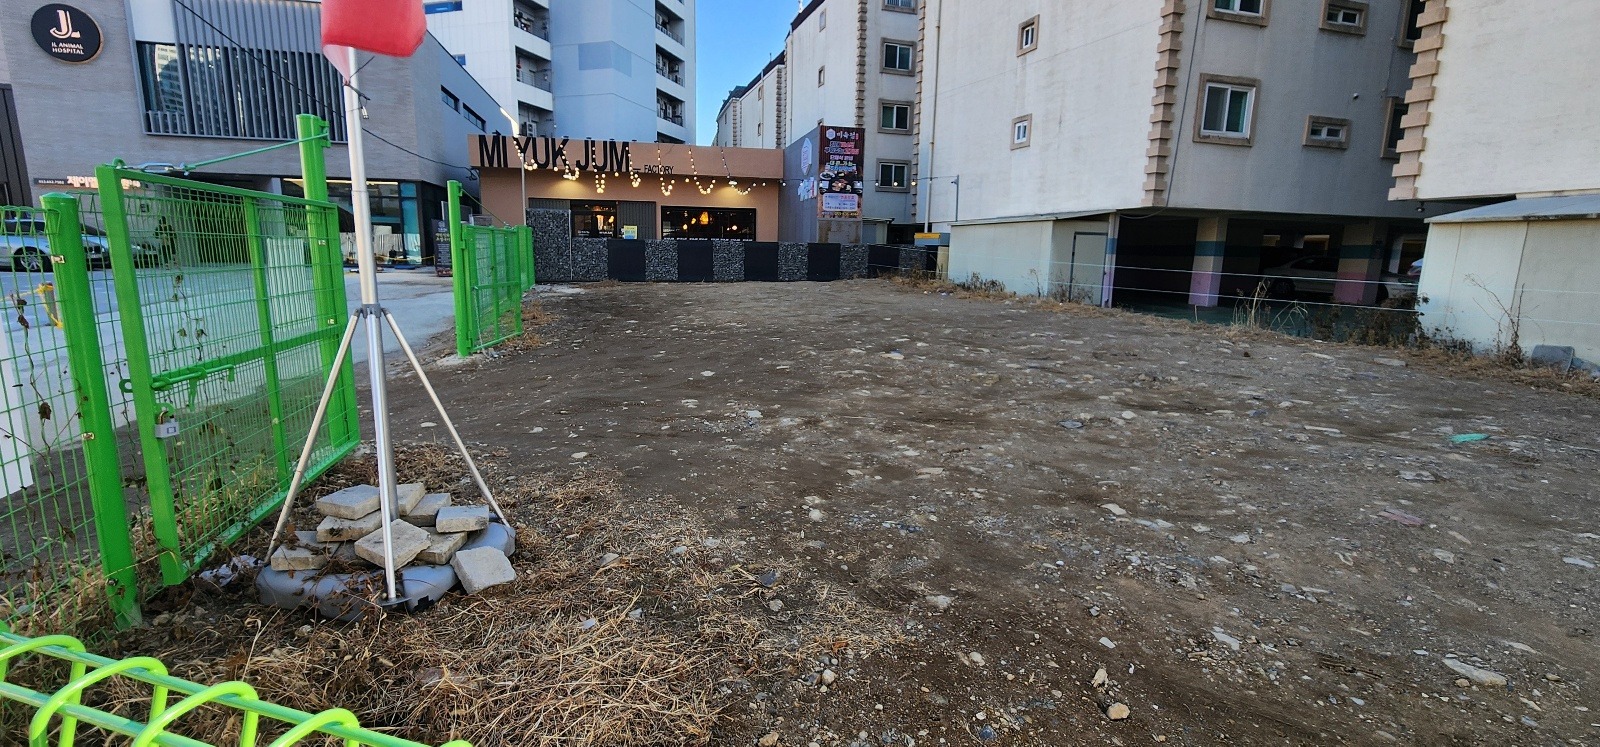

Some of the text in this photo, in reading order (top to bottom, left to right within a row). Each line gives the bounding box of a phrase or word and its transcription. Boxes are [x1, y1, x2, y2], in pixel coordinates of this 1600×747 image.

[478, 134, 630, 173] MI YUK JUM
[643, 164, 674, 174] FACTORY
